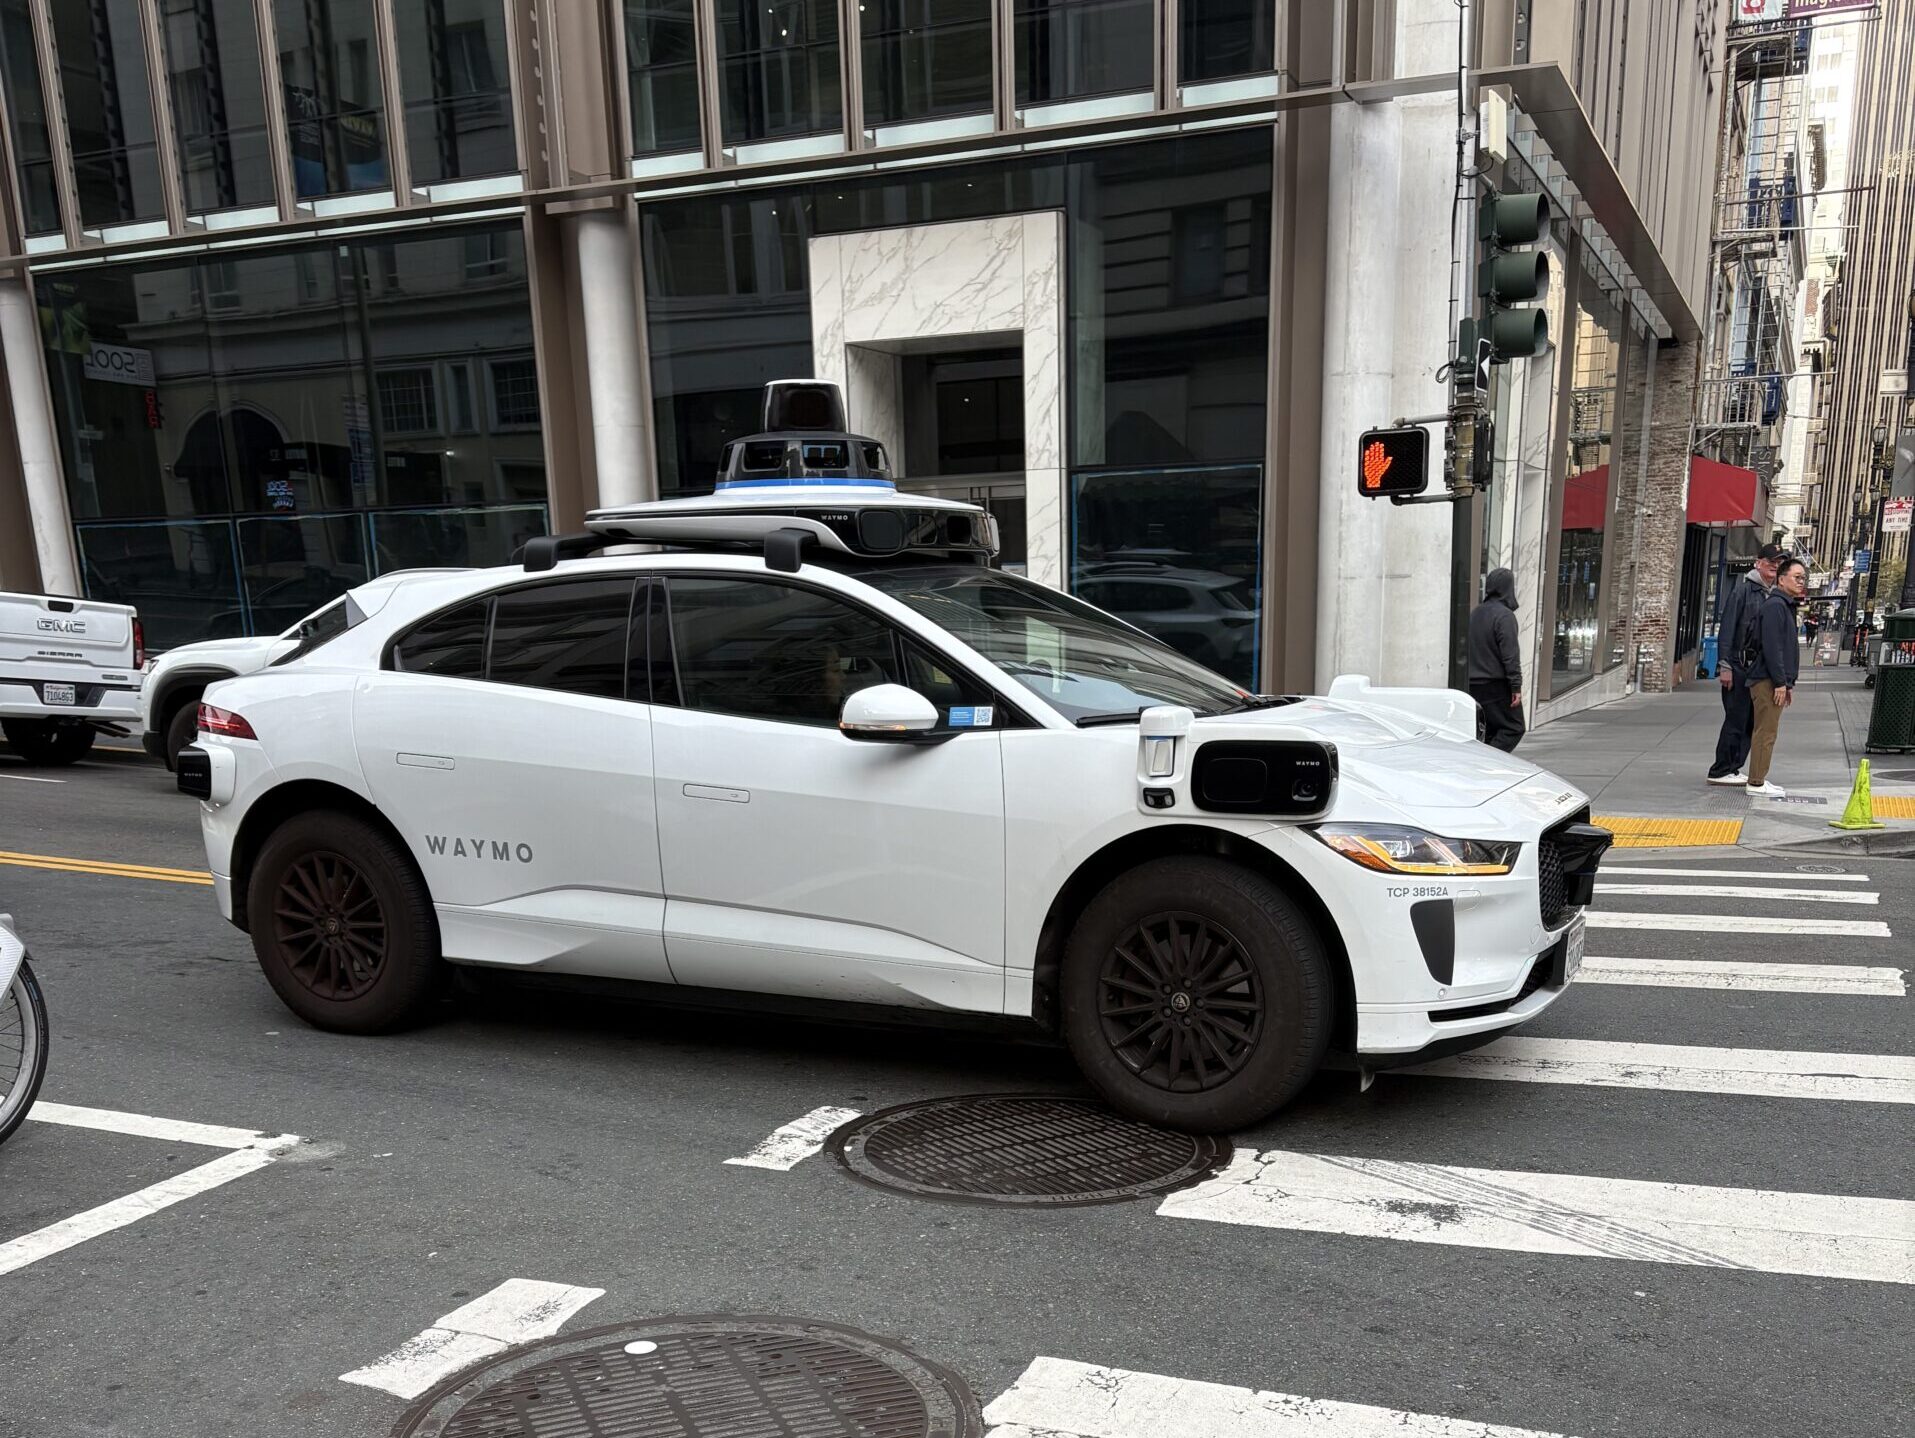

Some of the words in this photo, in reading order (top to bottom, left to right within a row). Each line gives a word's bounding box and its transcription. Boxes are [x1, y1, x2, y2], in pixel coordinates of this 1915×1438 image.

[37, 618, 86, 633] GMC
[425, 835, 533, 863] WAYMO
[1386, 887, 1410, 898] TCP
[1412, 886, 1449, 897] 38152A
